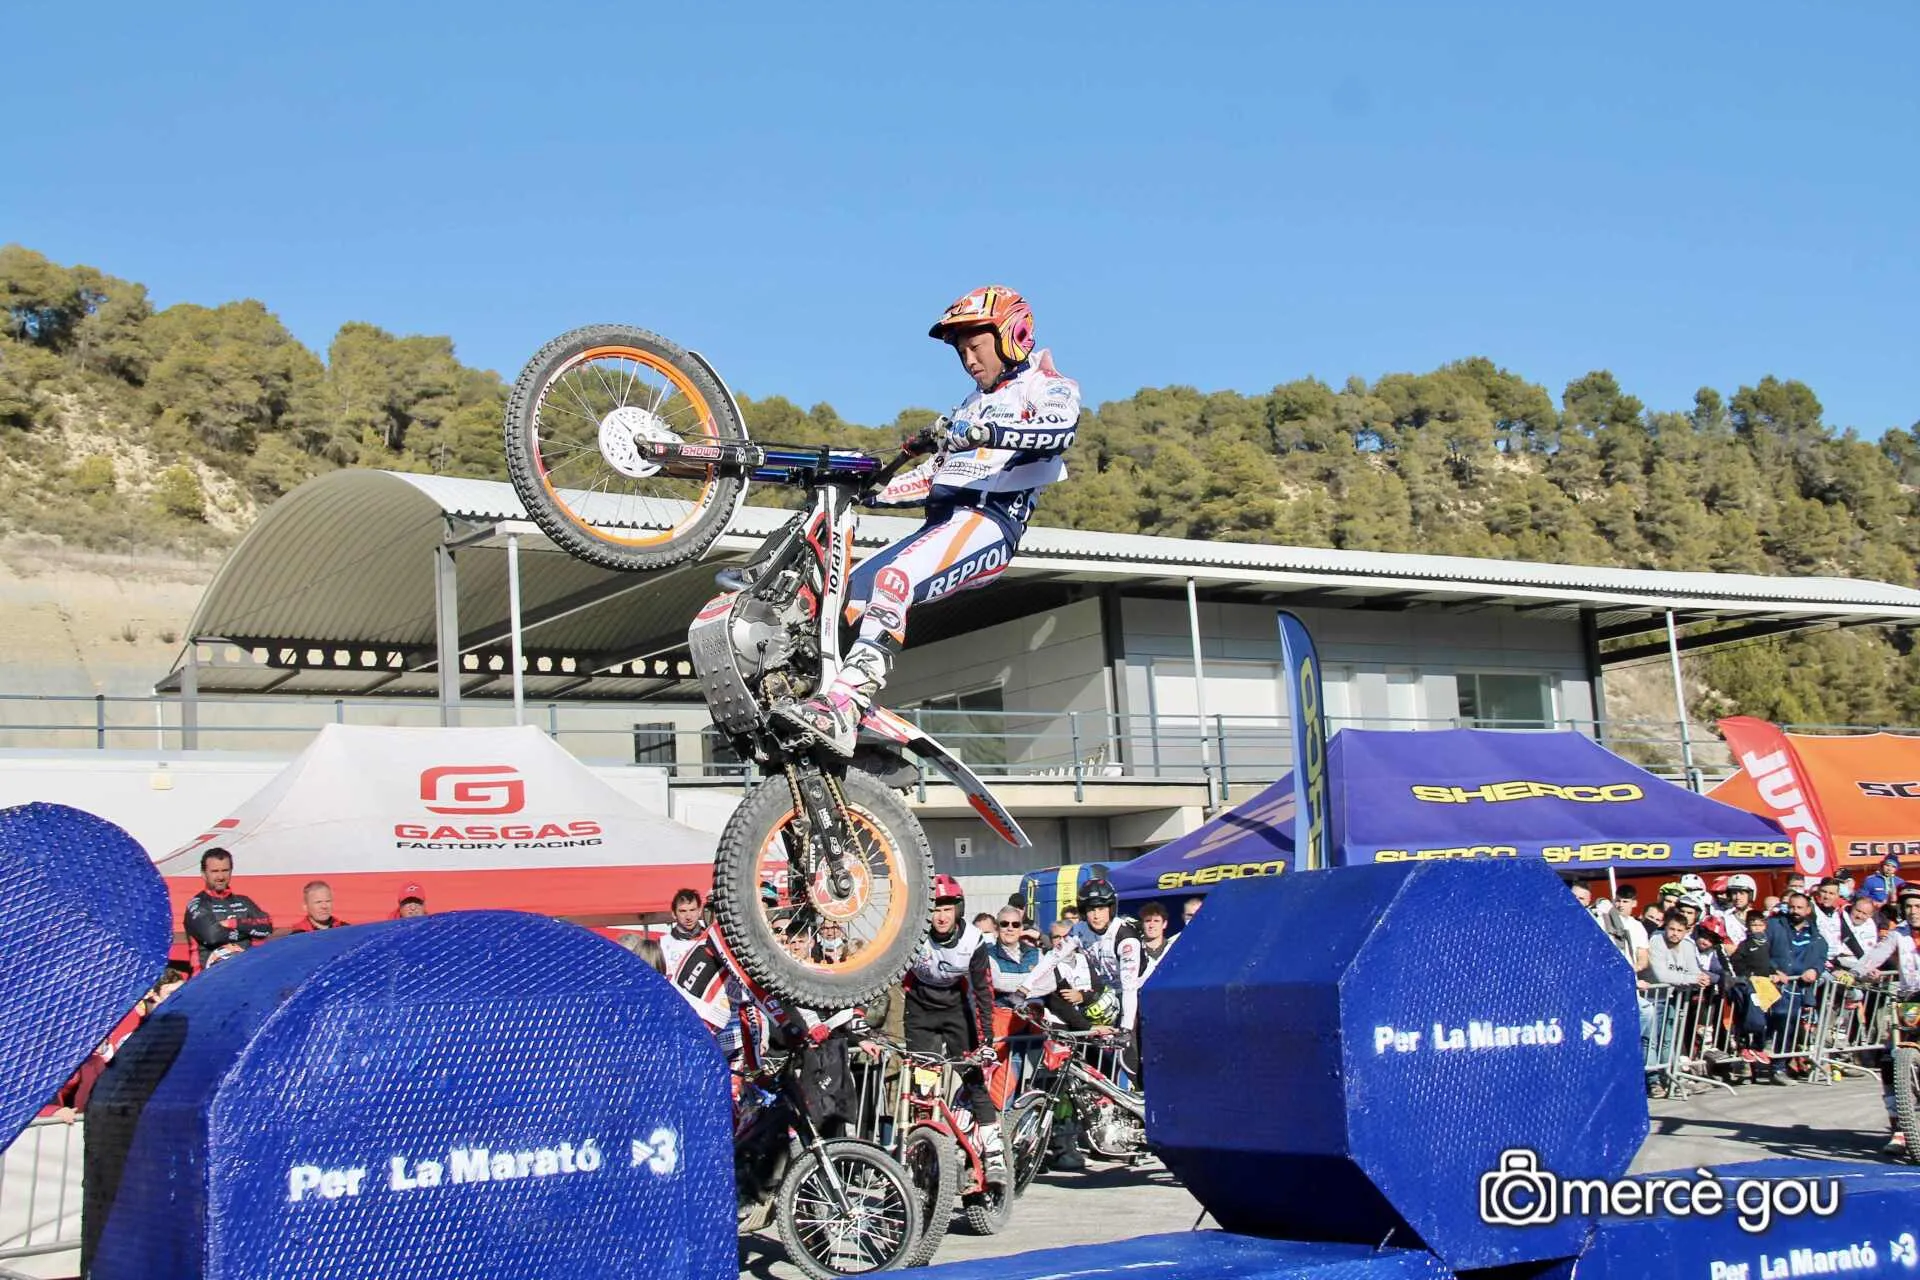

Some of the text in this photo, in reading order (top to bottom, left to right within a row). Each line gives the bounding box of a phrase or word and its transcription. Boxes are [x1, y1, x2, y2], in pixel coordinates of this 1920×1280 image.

[682, 445, 720, 458] SHOWA
[828, 531, 841, 595] REPSOL
[923, 545, 1008, 602] REPSOL
[1411, 780, 1645, 804] SHERCO
[394, 820, 602, 840] GASGAS
[397, 838, 603, 850] FACTORY RACING
[1542, 842, 1672, 864] SHERCO
[1158, 860, 1287, 890] SHERCO
[1374, 1025, 1421, 1054] Per
[288, 1164, 367, 1202] Per
[1710, 1260, 1749, 1280] Per
